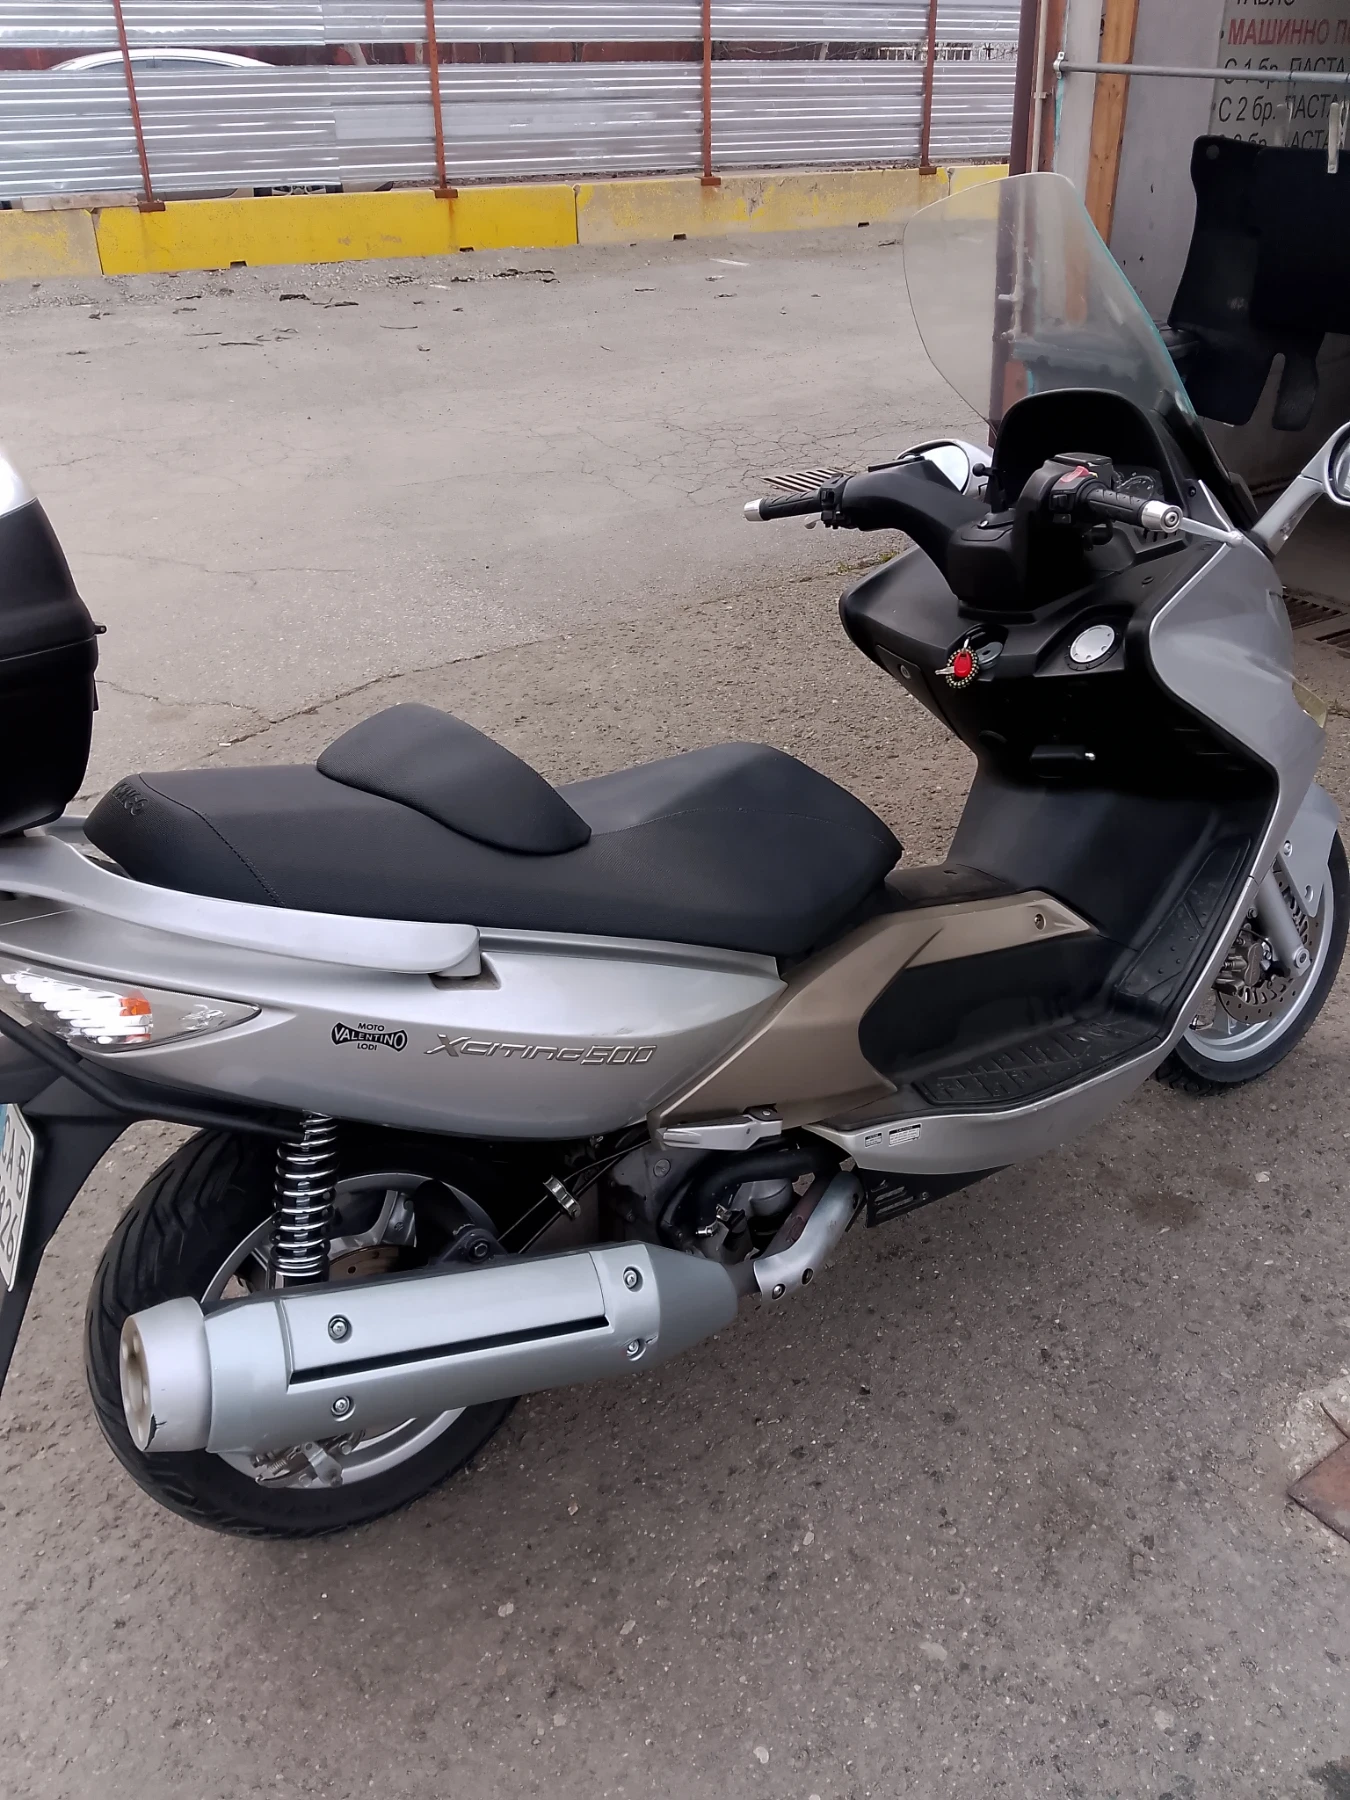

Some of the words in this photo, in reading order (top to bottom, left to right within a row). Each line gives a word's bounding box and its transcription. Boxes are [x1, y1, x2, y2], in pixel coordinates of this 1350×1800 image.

[1228, 18, 1330, 45] МАШИННО
[1333, 18, 1350, 45] П
[1218, 96, 1232, 122] С
[1235, 96, 1248, 122] 2
[1252, 95, 1276, 127] бр.
[333, 1026, 406, 1049] VALENTINO
[357, 1022, 385, 1032] MOTO
[357, 1042, 378, 1051] LODI
